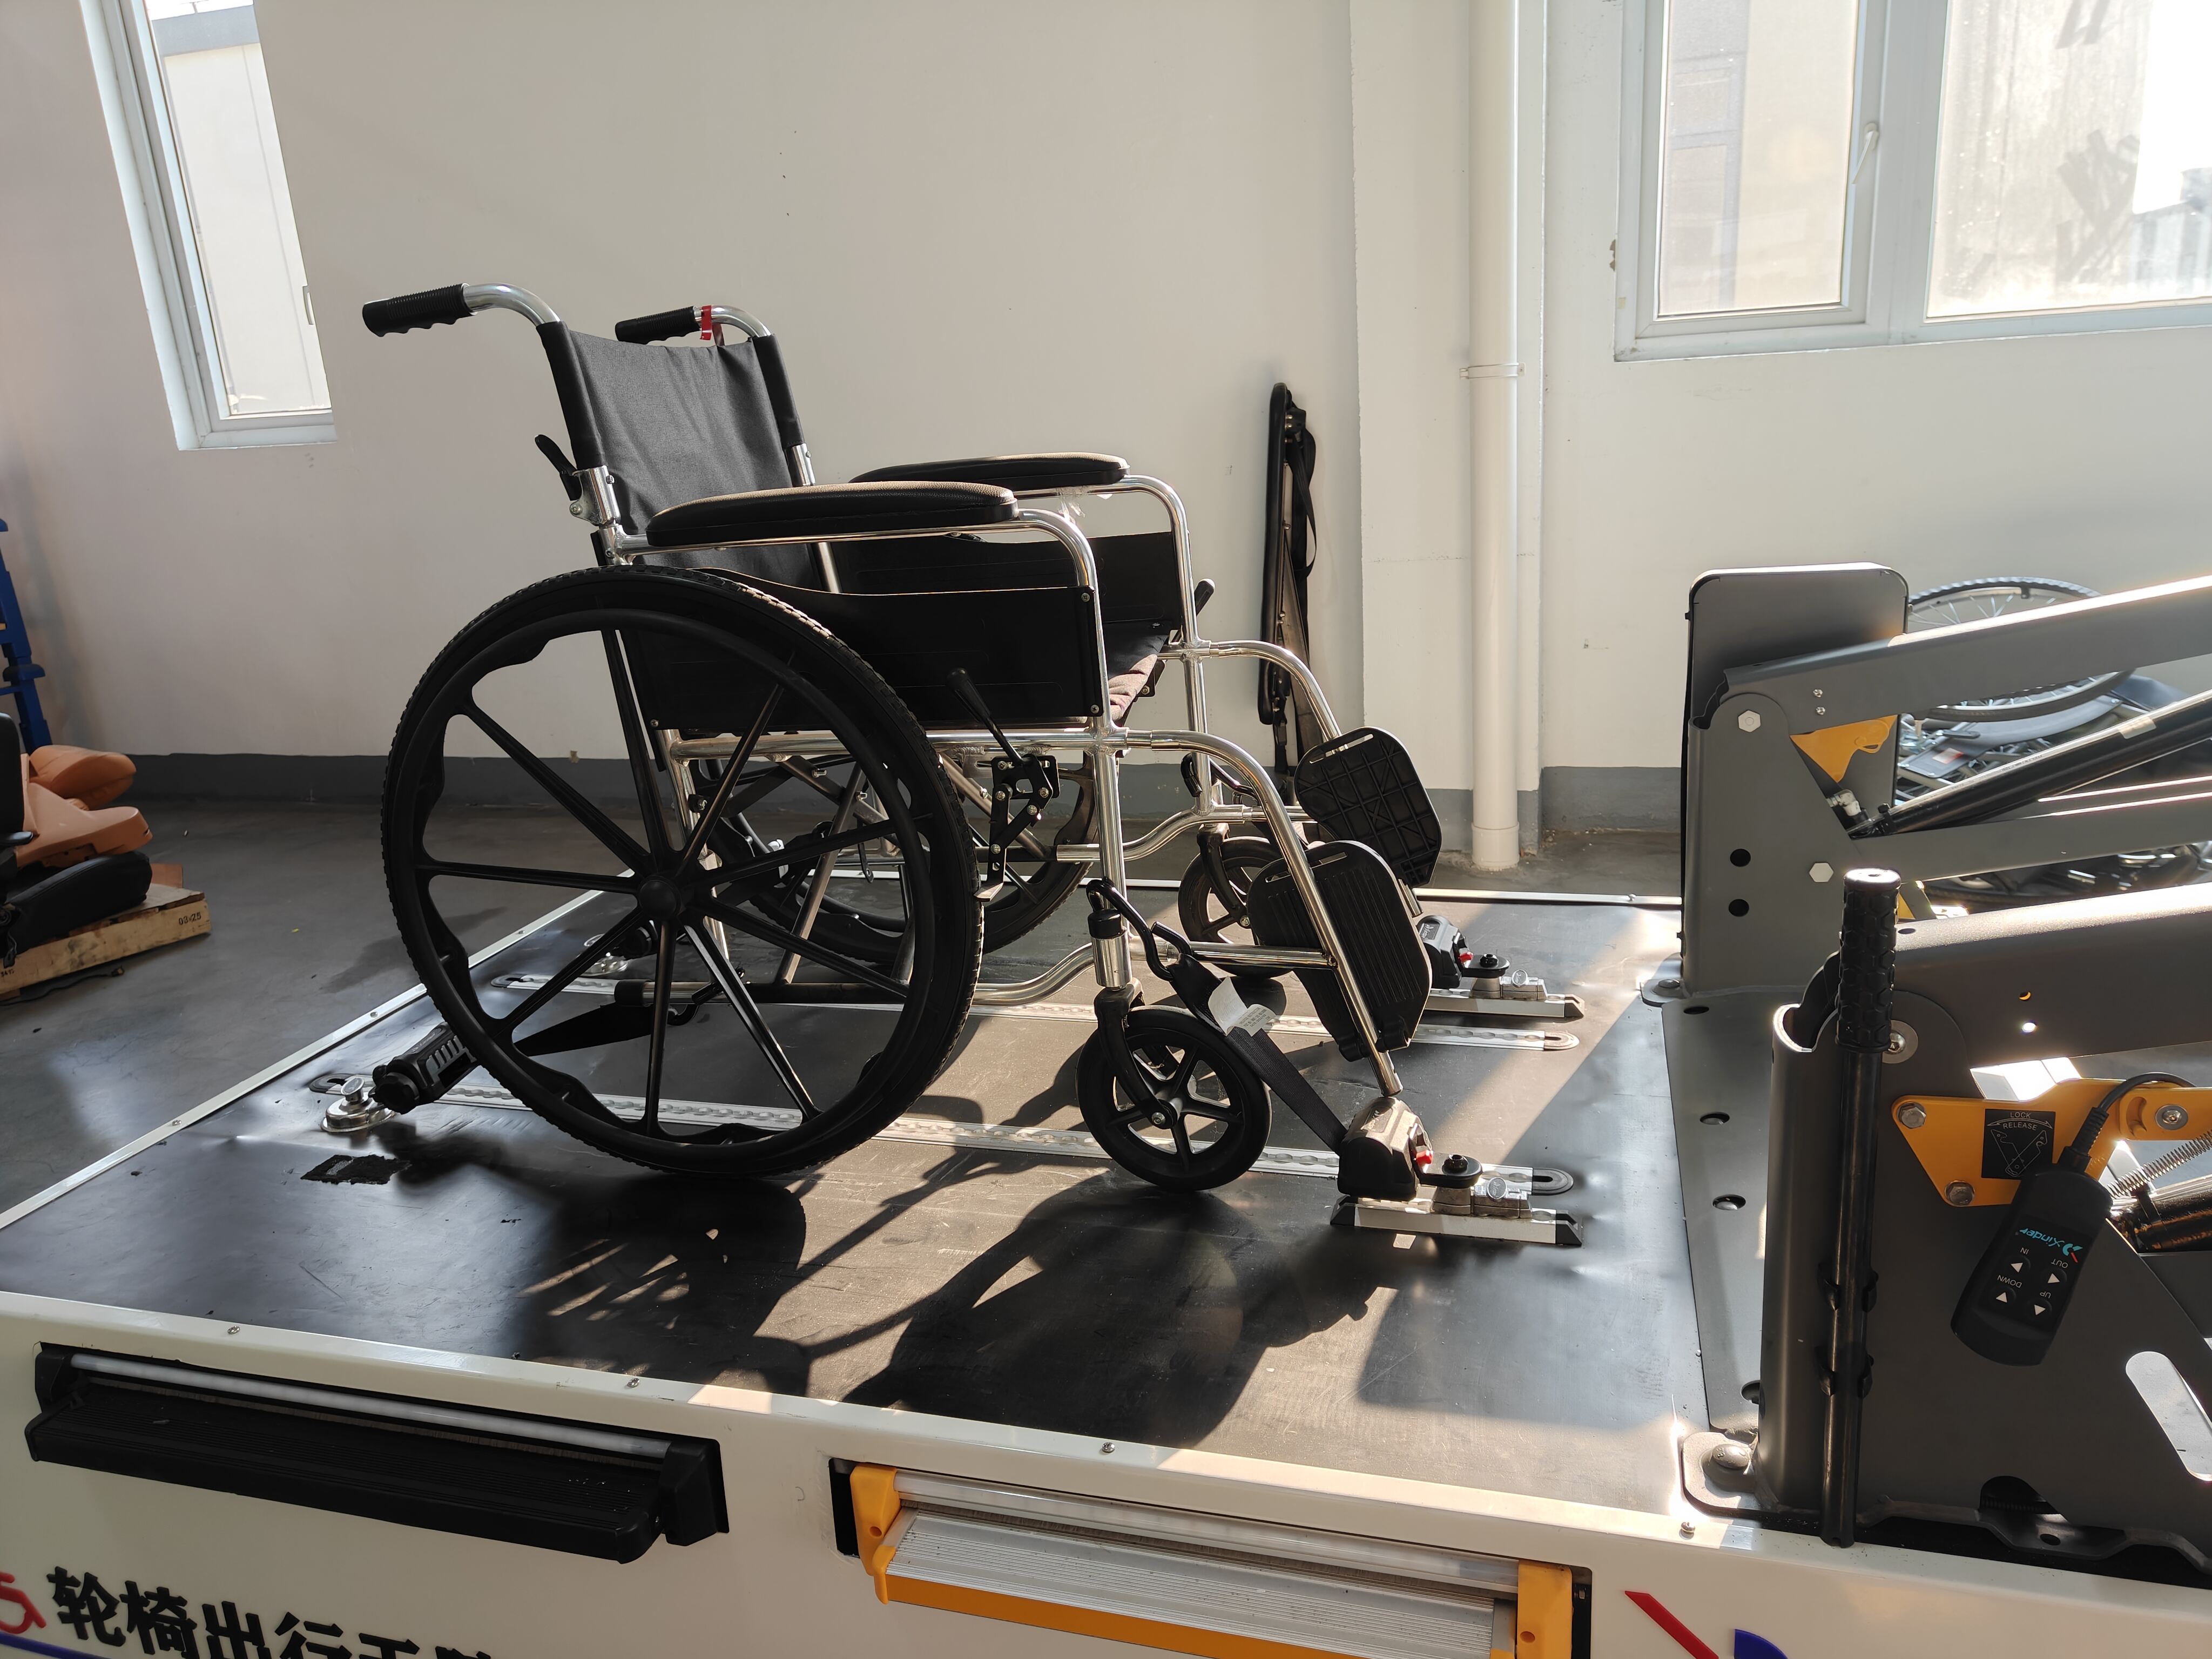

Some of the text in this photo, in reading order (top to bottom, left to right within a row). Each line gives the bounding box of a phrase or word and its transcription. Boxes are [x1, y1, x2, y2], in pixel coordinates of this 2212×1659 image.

[2002, 1122, 2038, 1131] RELEASE
[2020, 1247, 2029, 1255] IN
[2051, 1258, 2069, 1269] OUT
[1997, 1275, 2022, 1289] DOWN
[46, 1566, 491, 1659] 轮椅出行
